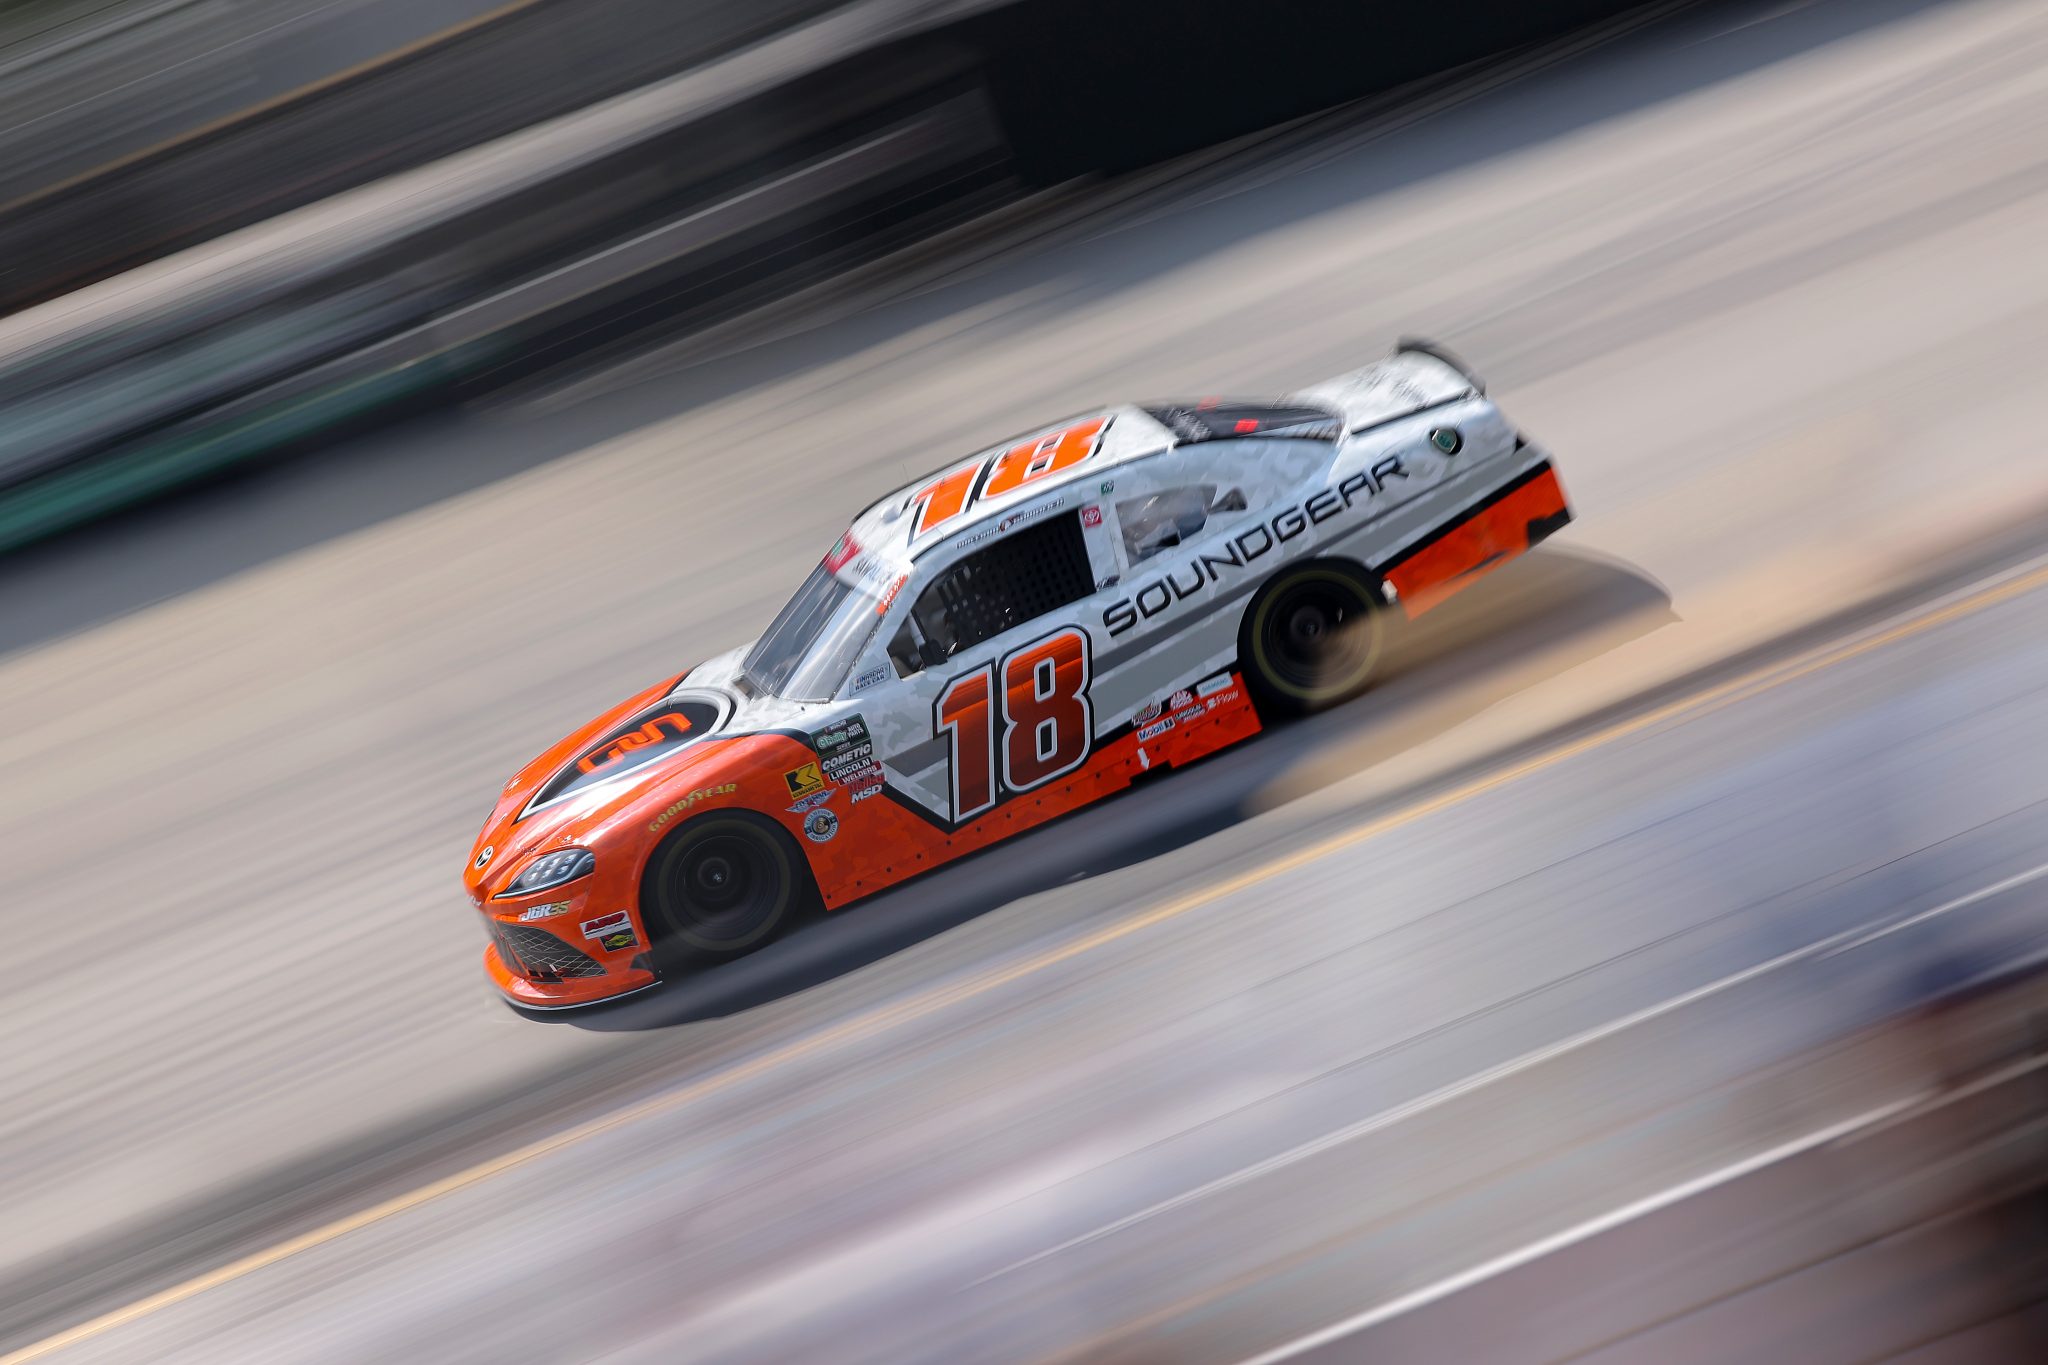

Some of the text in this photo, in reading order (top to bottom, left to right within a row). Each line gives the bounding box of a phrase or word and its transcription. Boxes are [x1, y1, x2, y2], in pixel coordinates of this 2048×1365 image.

[910, 414, 1112, 538] 18
[1102, 455, 1409, 638] SOUNDGEAR
[932, 624, 1093, 829] 18
[1139, 723, 1164, 740] Mobil
[822, 743, 871, 771] COMETIC
[829, 758, 870, 780] LINCOLN
[841, 765, 877, 784] WELDERS
[648, 783, 737, 832] GOODYEAR
[850, 784, 883, 804] MSD
